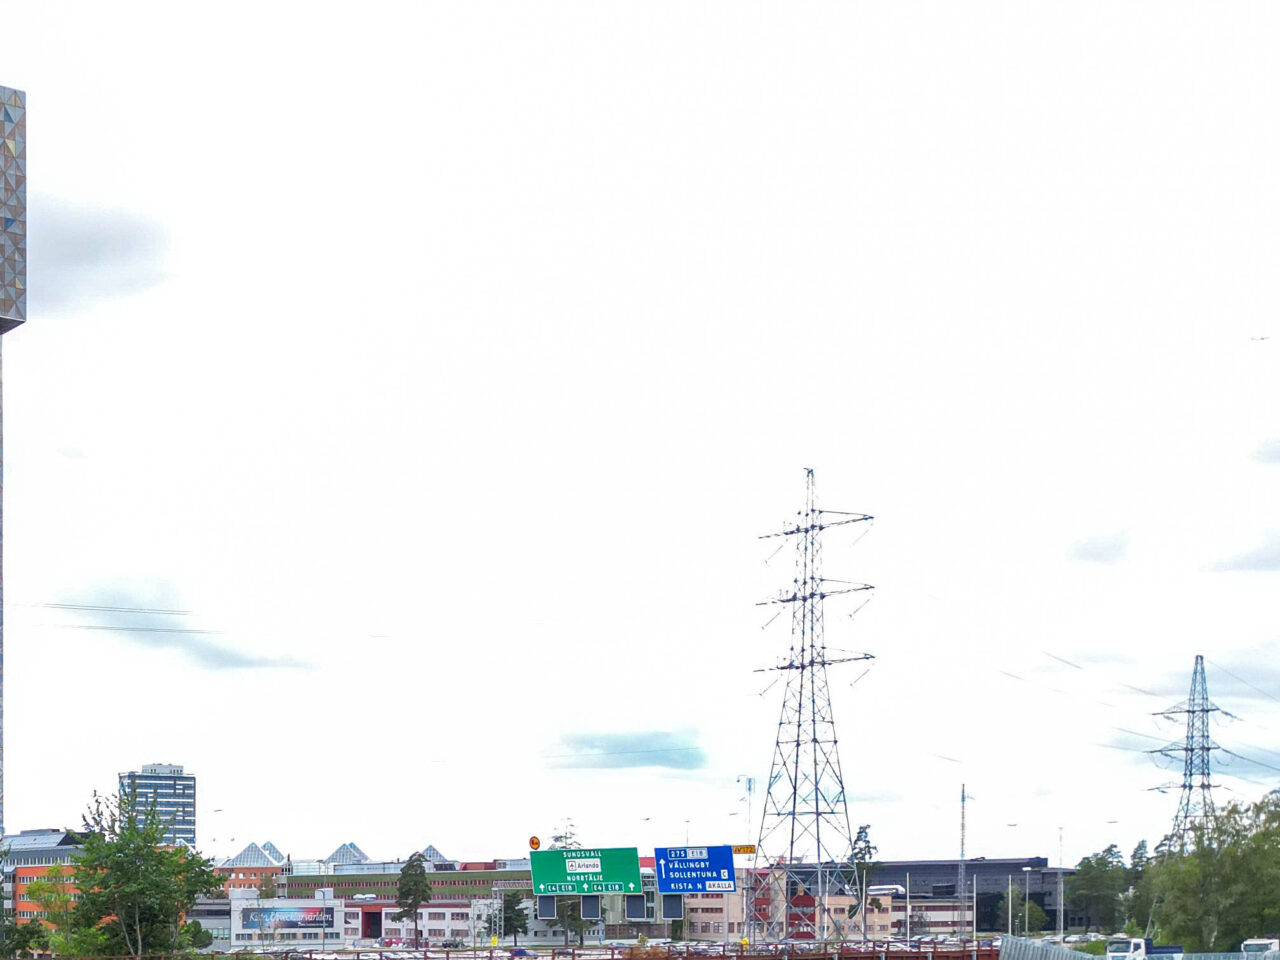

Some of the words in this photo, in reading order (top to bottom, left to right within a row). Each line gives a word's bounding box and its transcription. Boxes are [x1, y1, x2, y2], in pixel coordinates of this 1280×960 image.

[562, 850, 602, 858] SUNDSVALL
[670, 850, 685, 858] 275
[668, 860, 710, 869] VÄLLINGBY
[669, 870, 718, 878] SOLLENTUNA
[671, 882, 693, 890] KISTA
